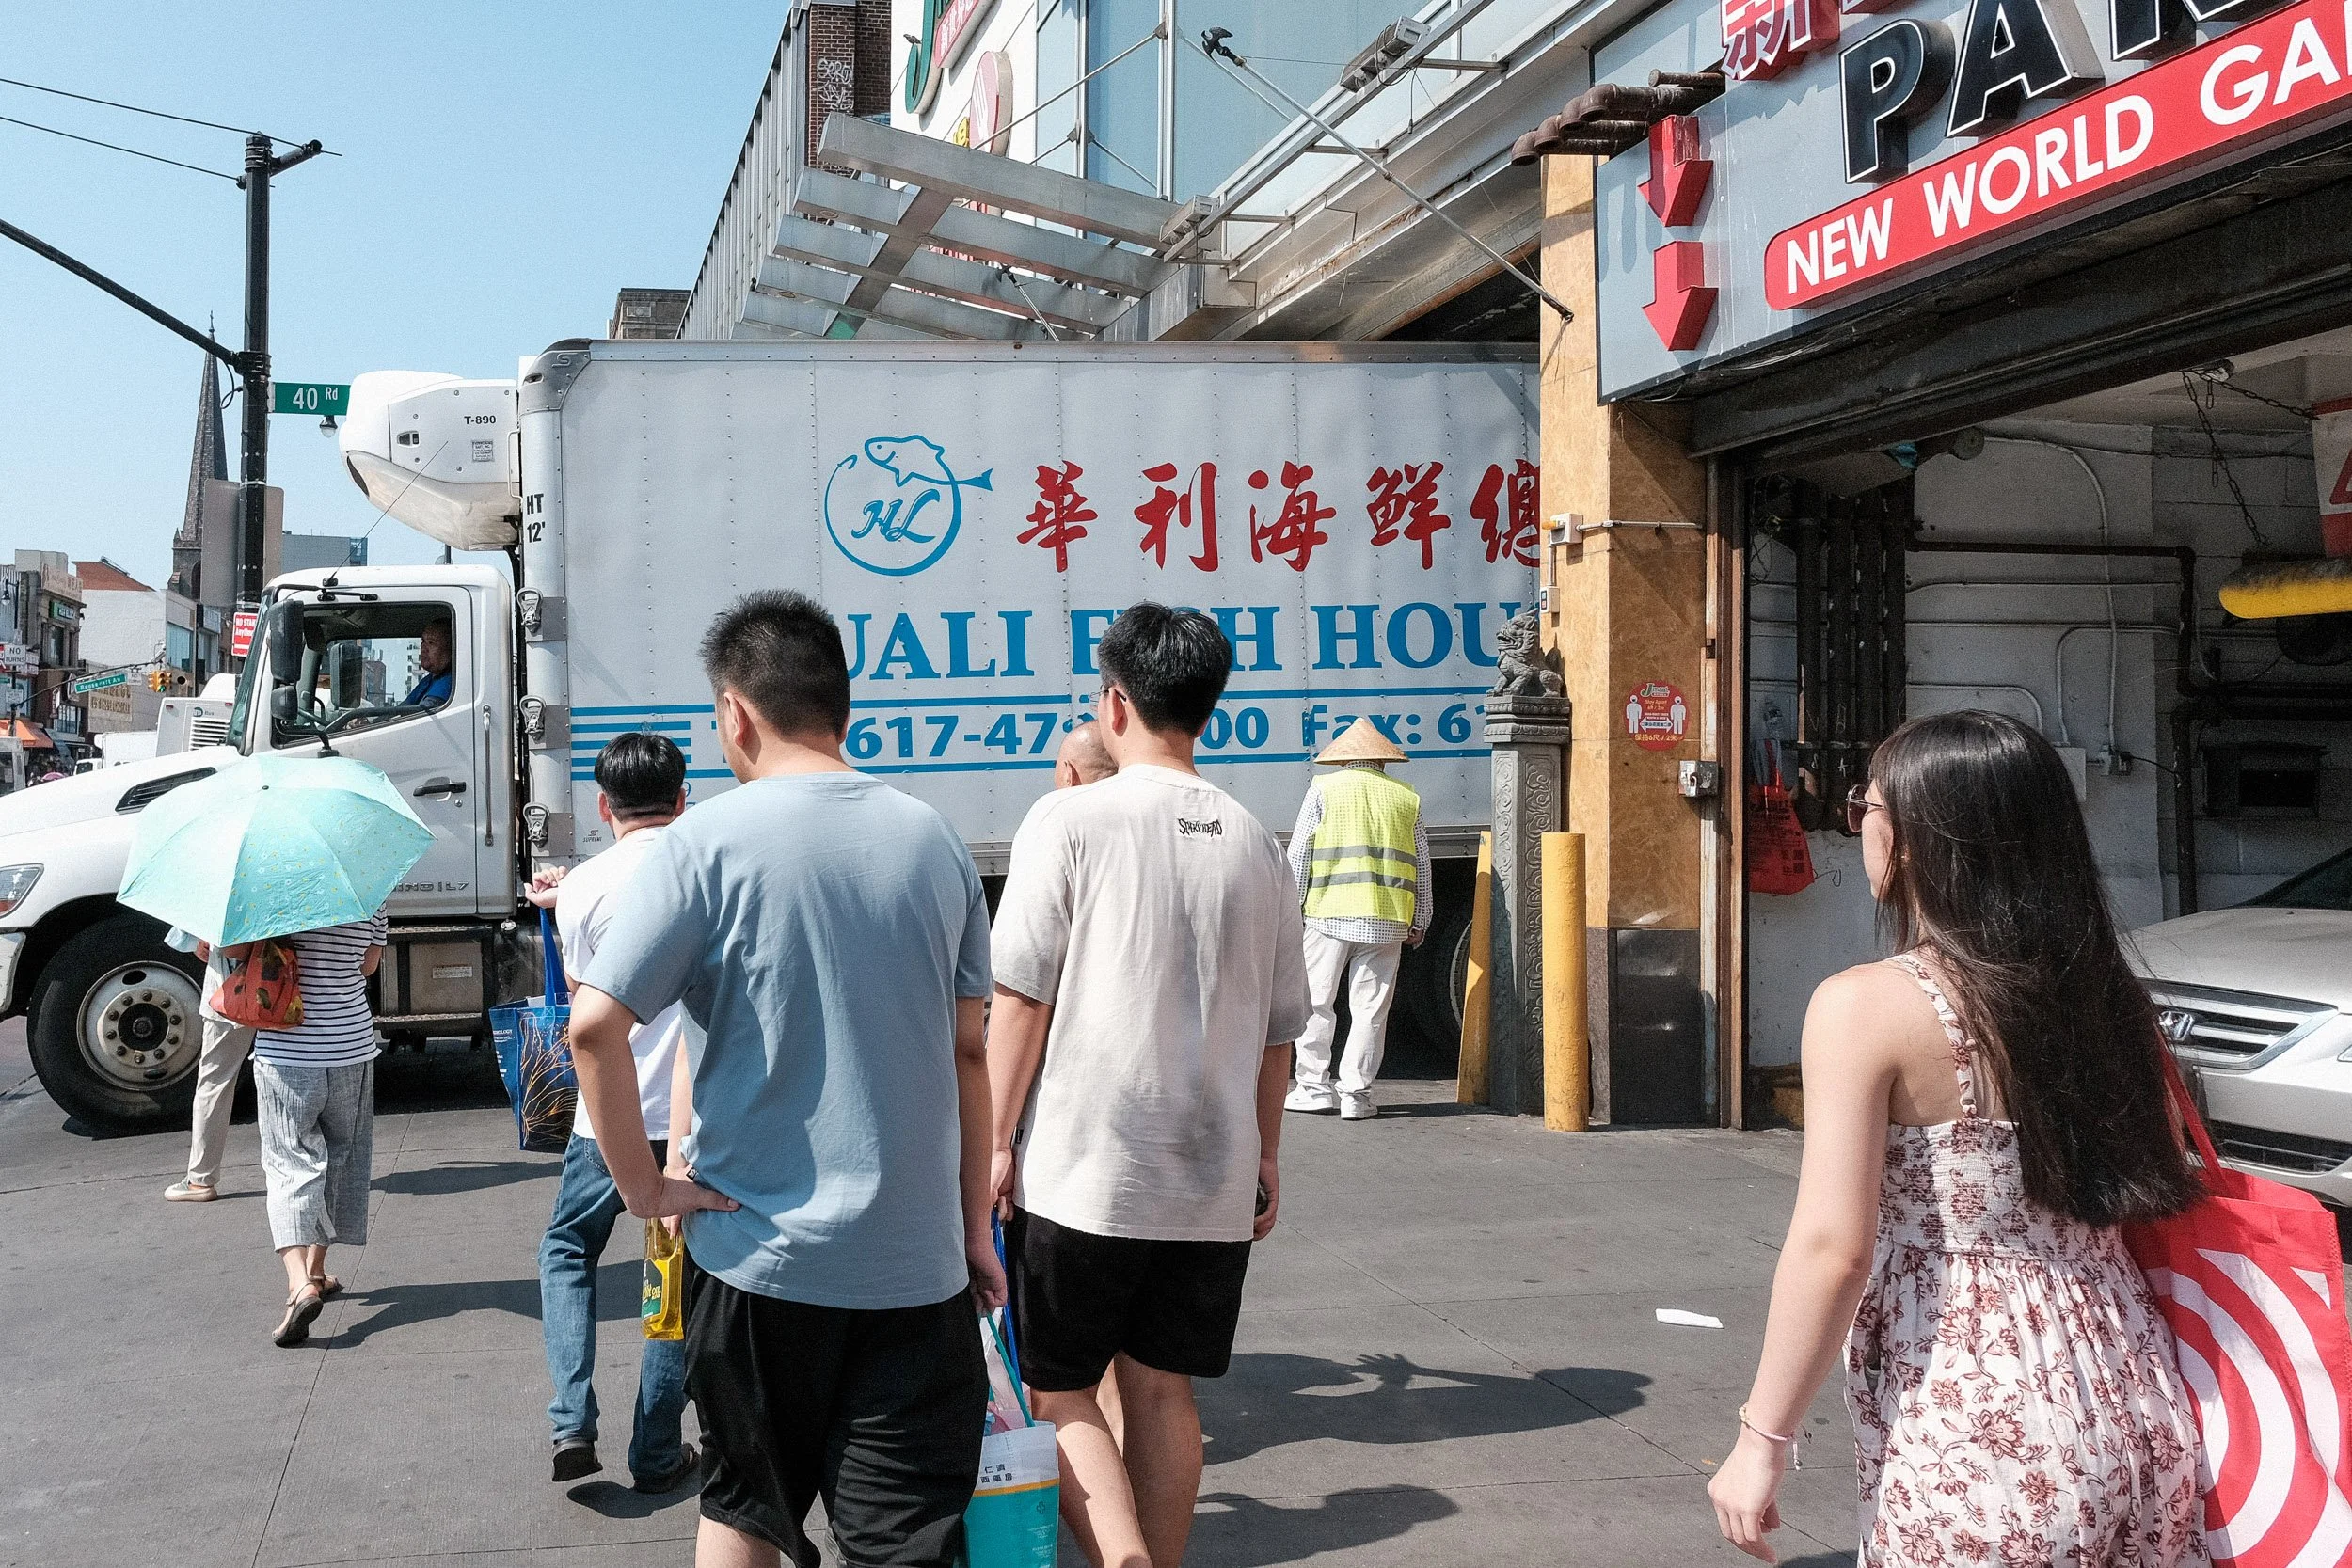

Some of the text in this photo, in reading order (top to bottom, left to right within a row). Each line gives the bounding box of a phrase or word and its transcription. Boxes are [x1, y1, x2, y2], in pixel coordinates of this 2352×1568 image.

[1786, 0, 2352, 295] NEW WORLD GA
[293, 386, 339, 411] 40 Rd
[464, 415, 497, 425] T-890
[526, 493, 545, 515] HT
[527, 521, 547, 544] 12'
[1070, 606, 1283, 675] FH
[1310, 601, 1539, 670] HOU
